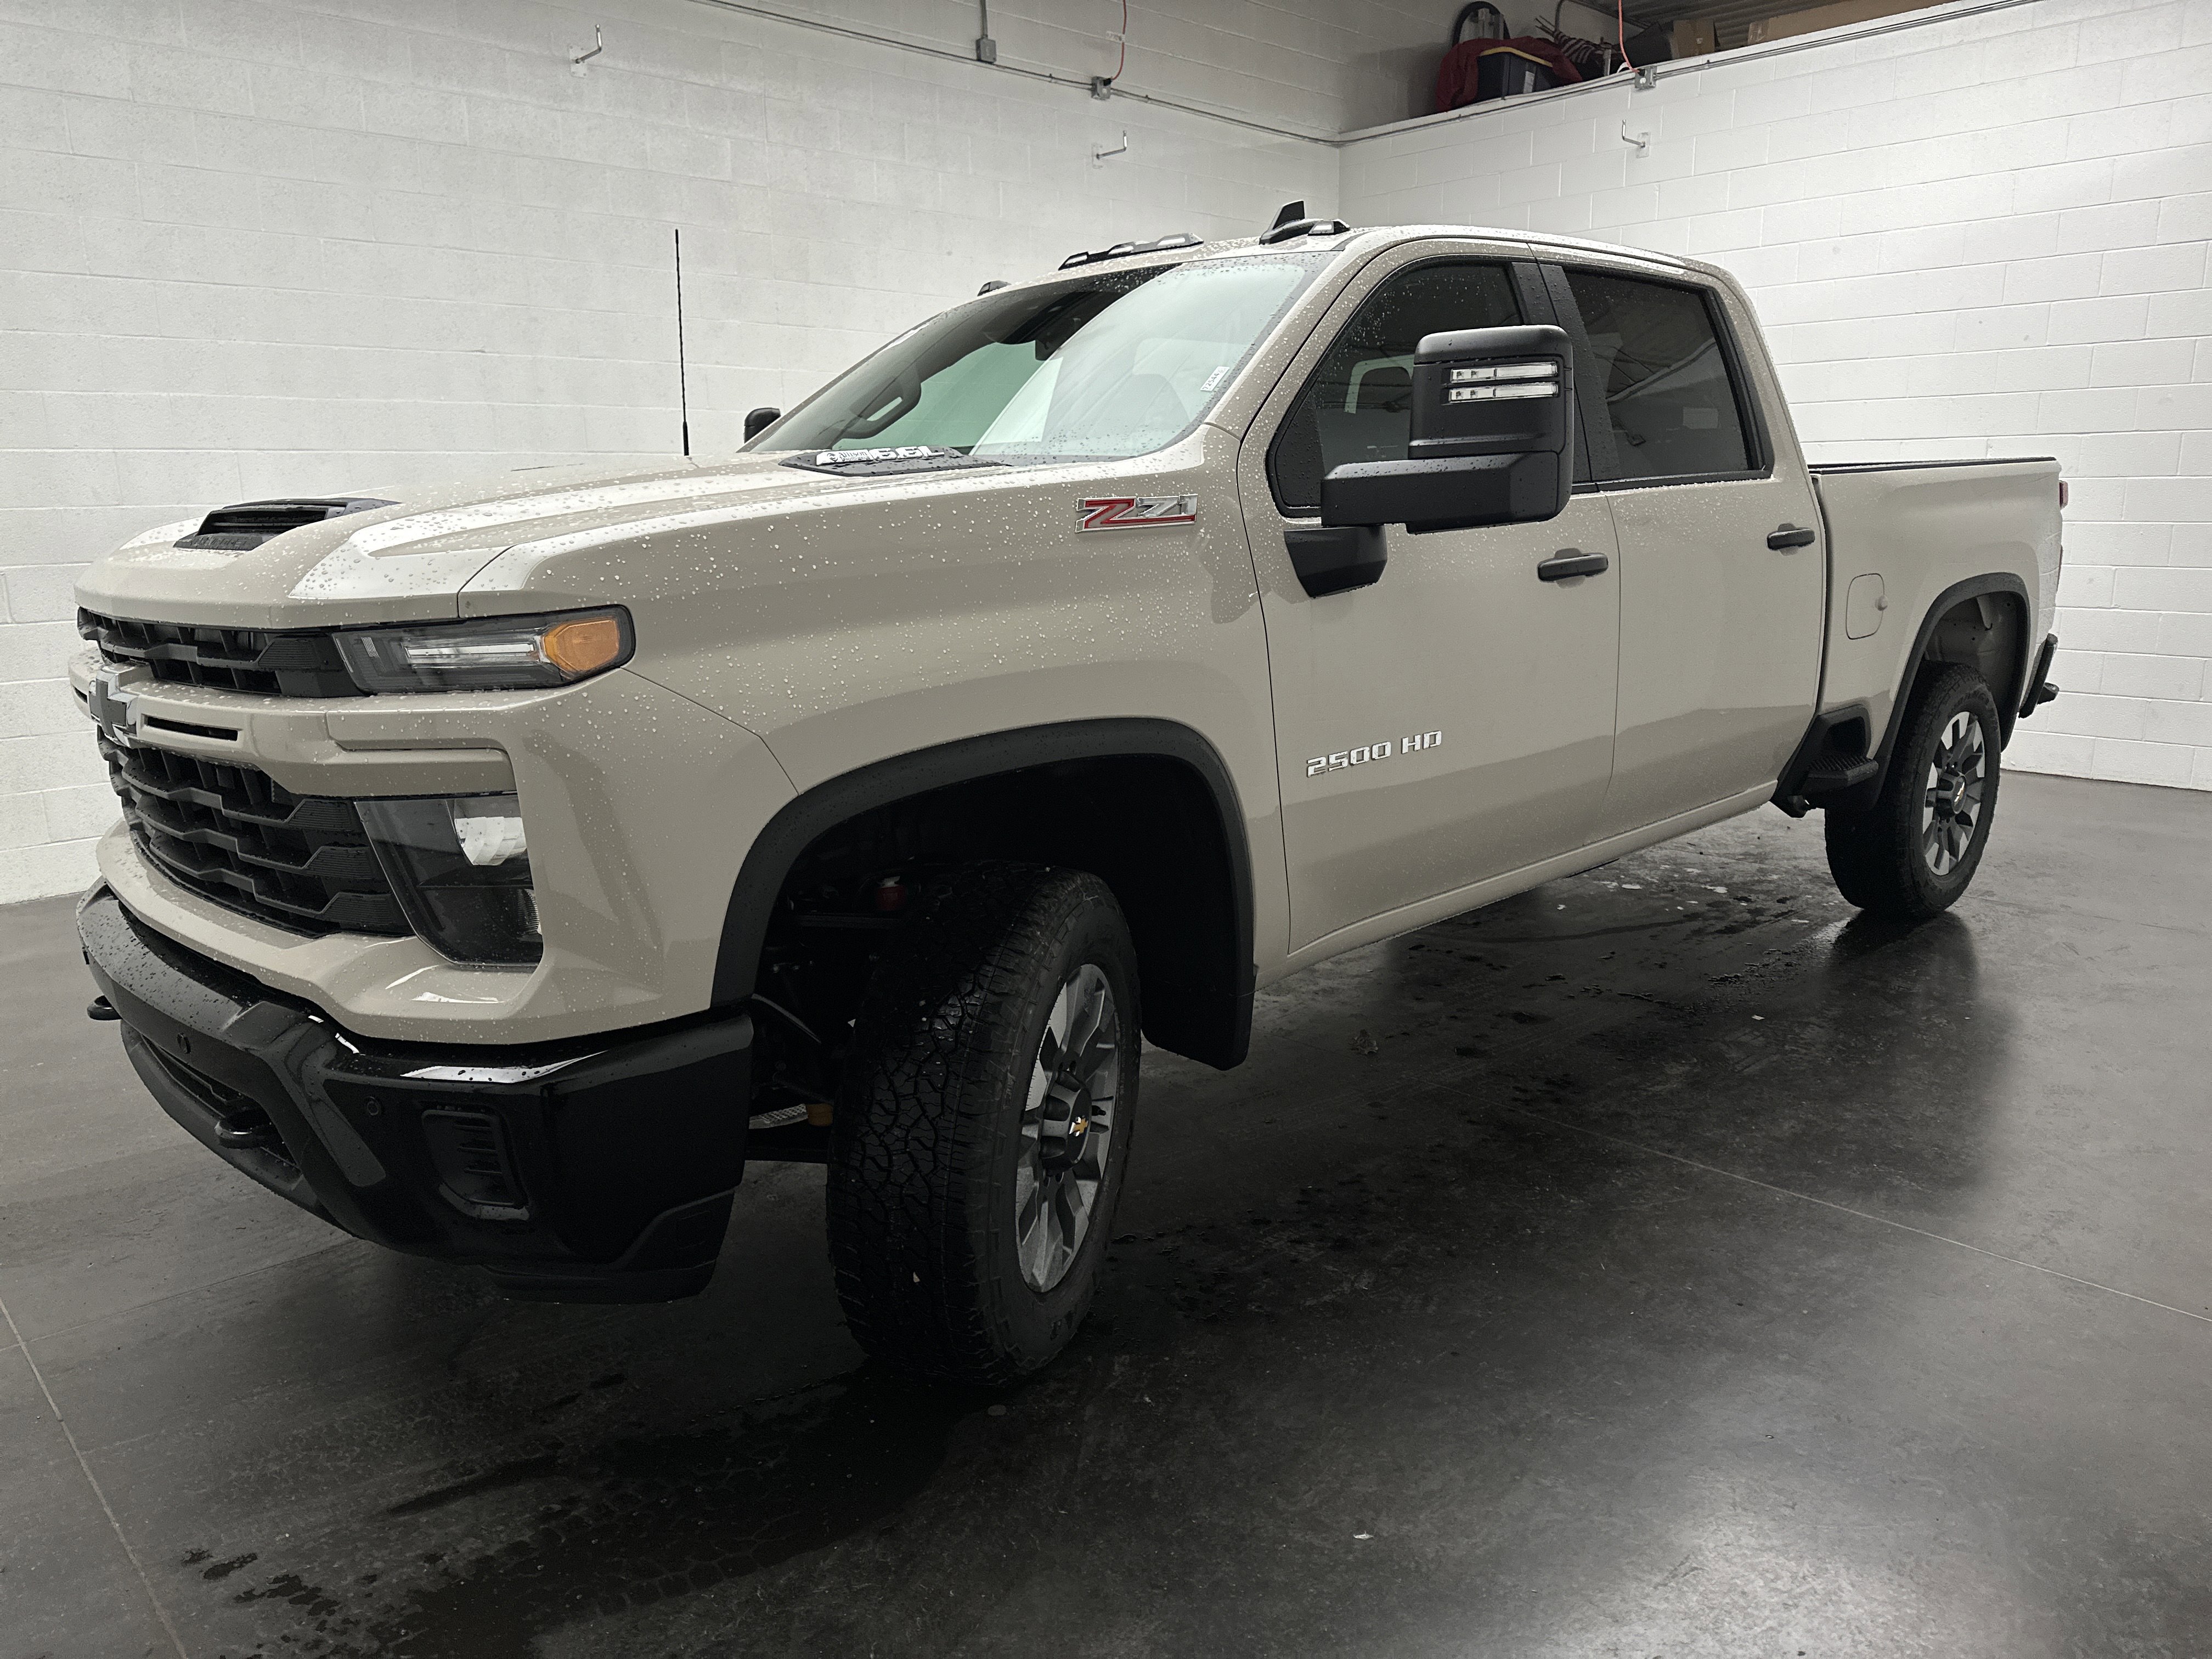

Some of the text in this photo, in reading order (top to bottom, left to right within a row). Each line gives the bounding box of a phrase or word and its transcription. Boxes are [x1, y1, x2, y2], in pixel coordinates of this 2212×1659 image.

[1075, 493, 1199, 534] Z71
[1306, 730, 1442, 777] 2500 HD
